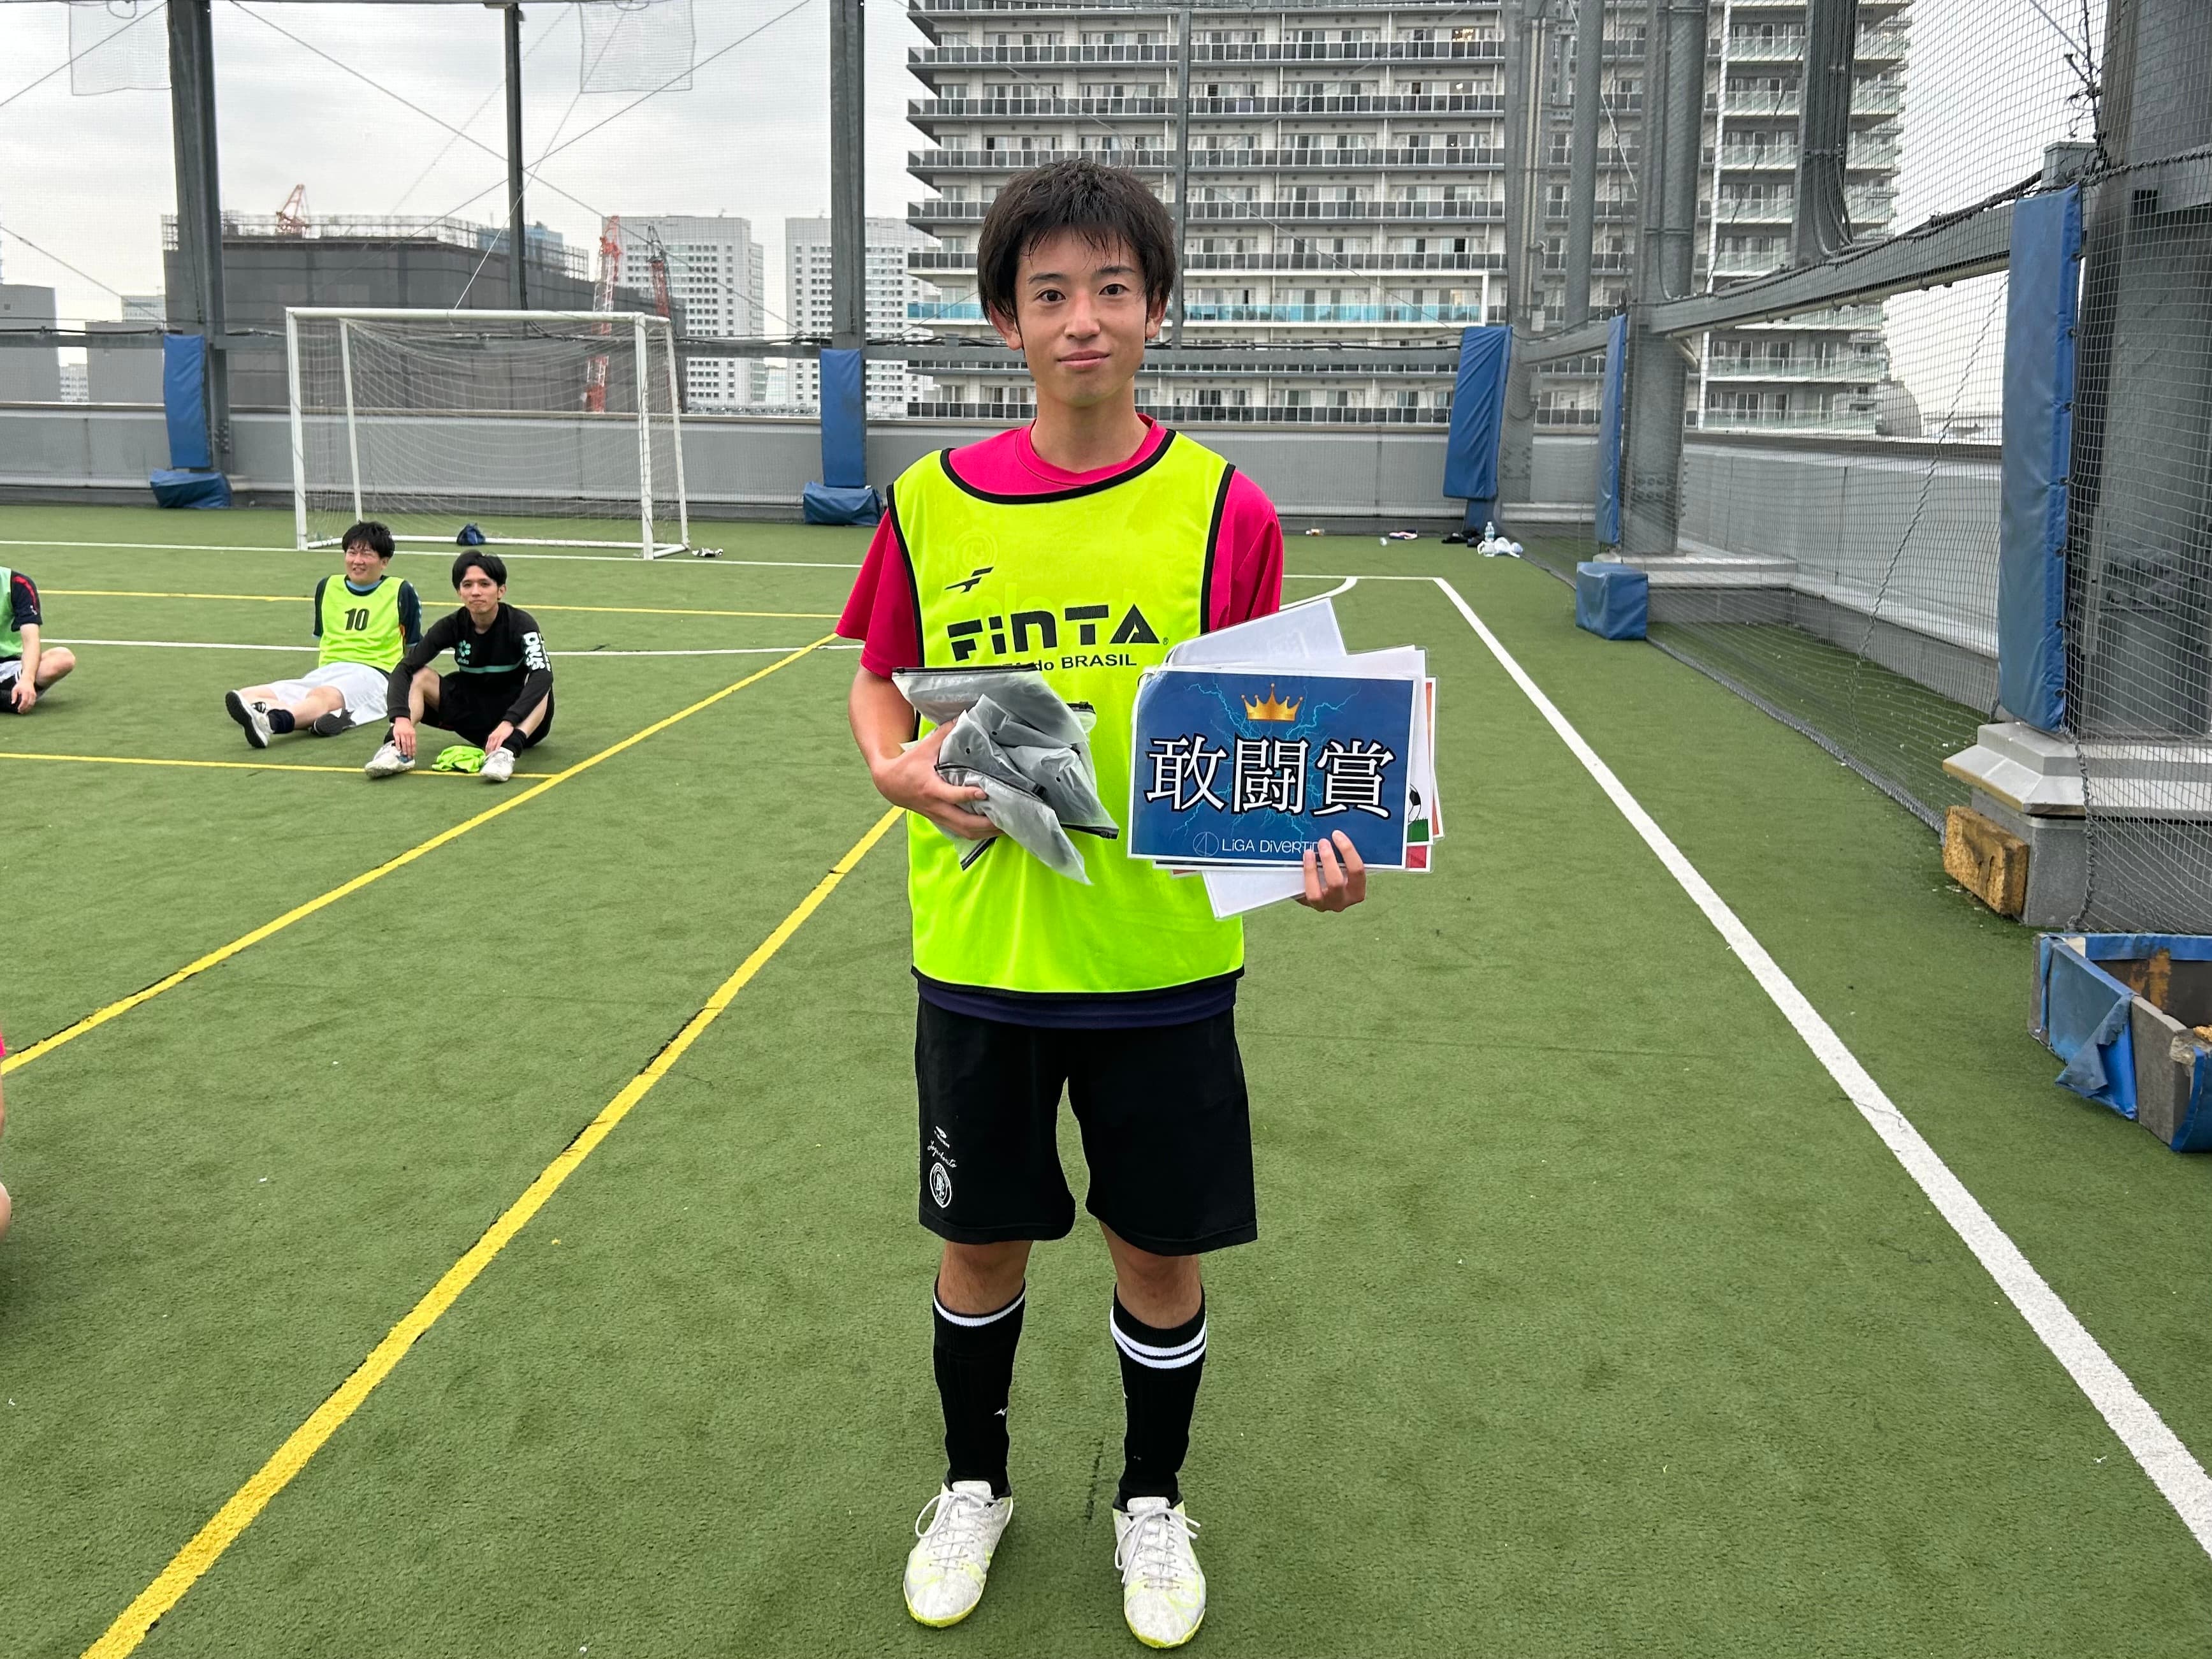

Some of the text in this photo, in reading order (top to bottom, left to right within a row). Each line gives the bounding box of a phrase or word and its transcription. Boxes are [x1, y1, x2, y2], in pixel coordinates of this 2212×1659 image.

[344, 608, 370, 631] 10
[1061, 654, 1137, 669] BRASIL
[1146, 733, 1395, 818] 敢闘賞
